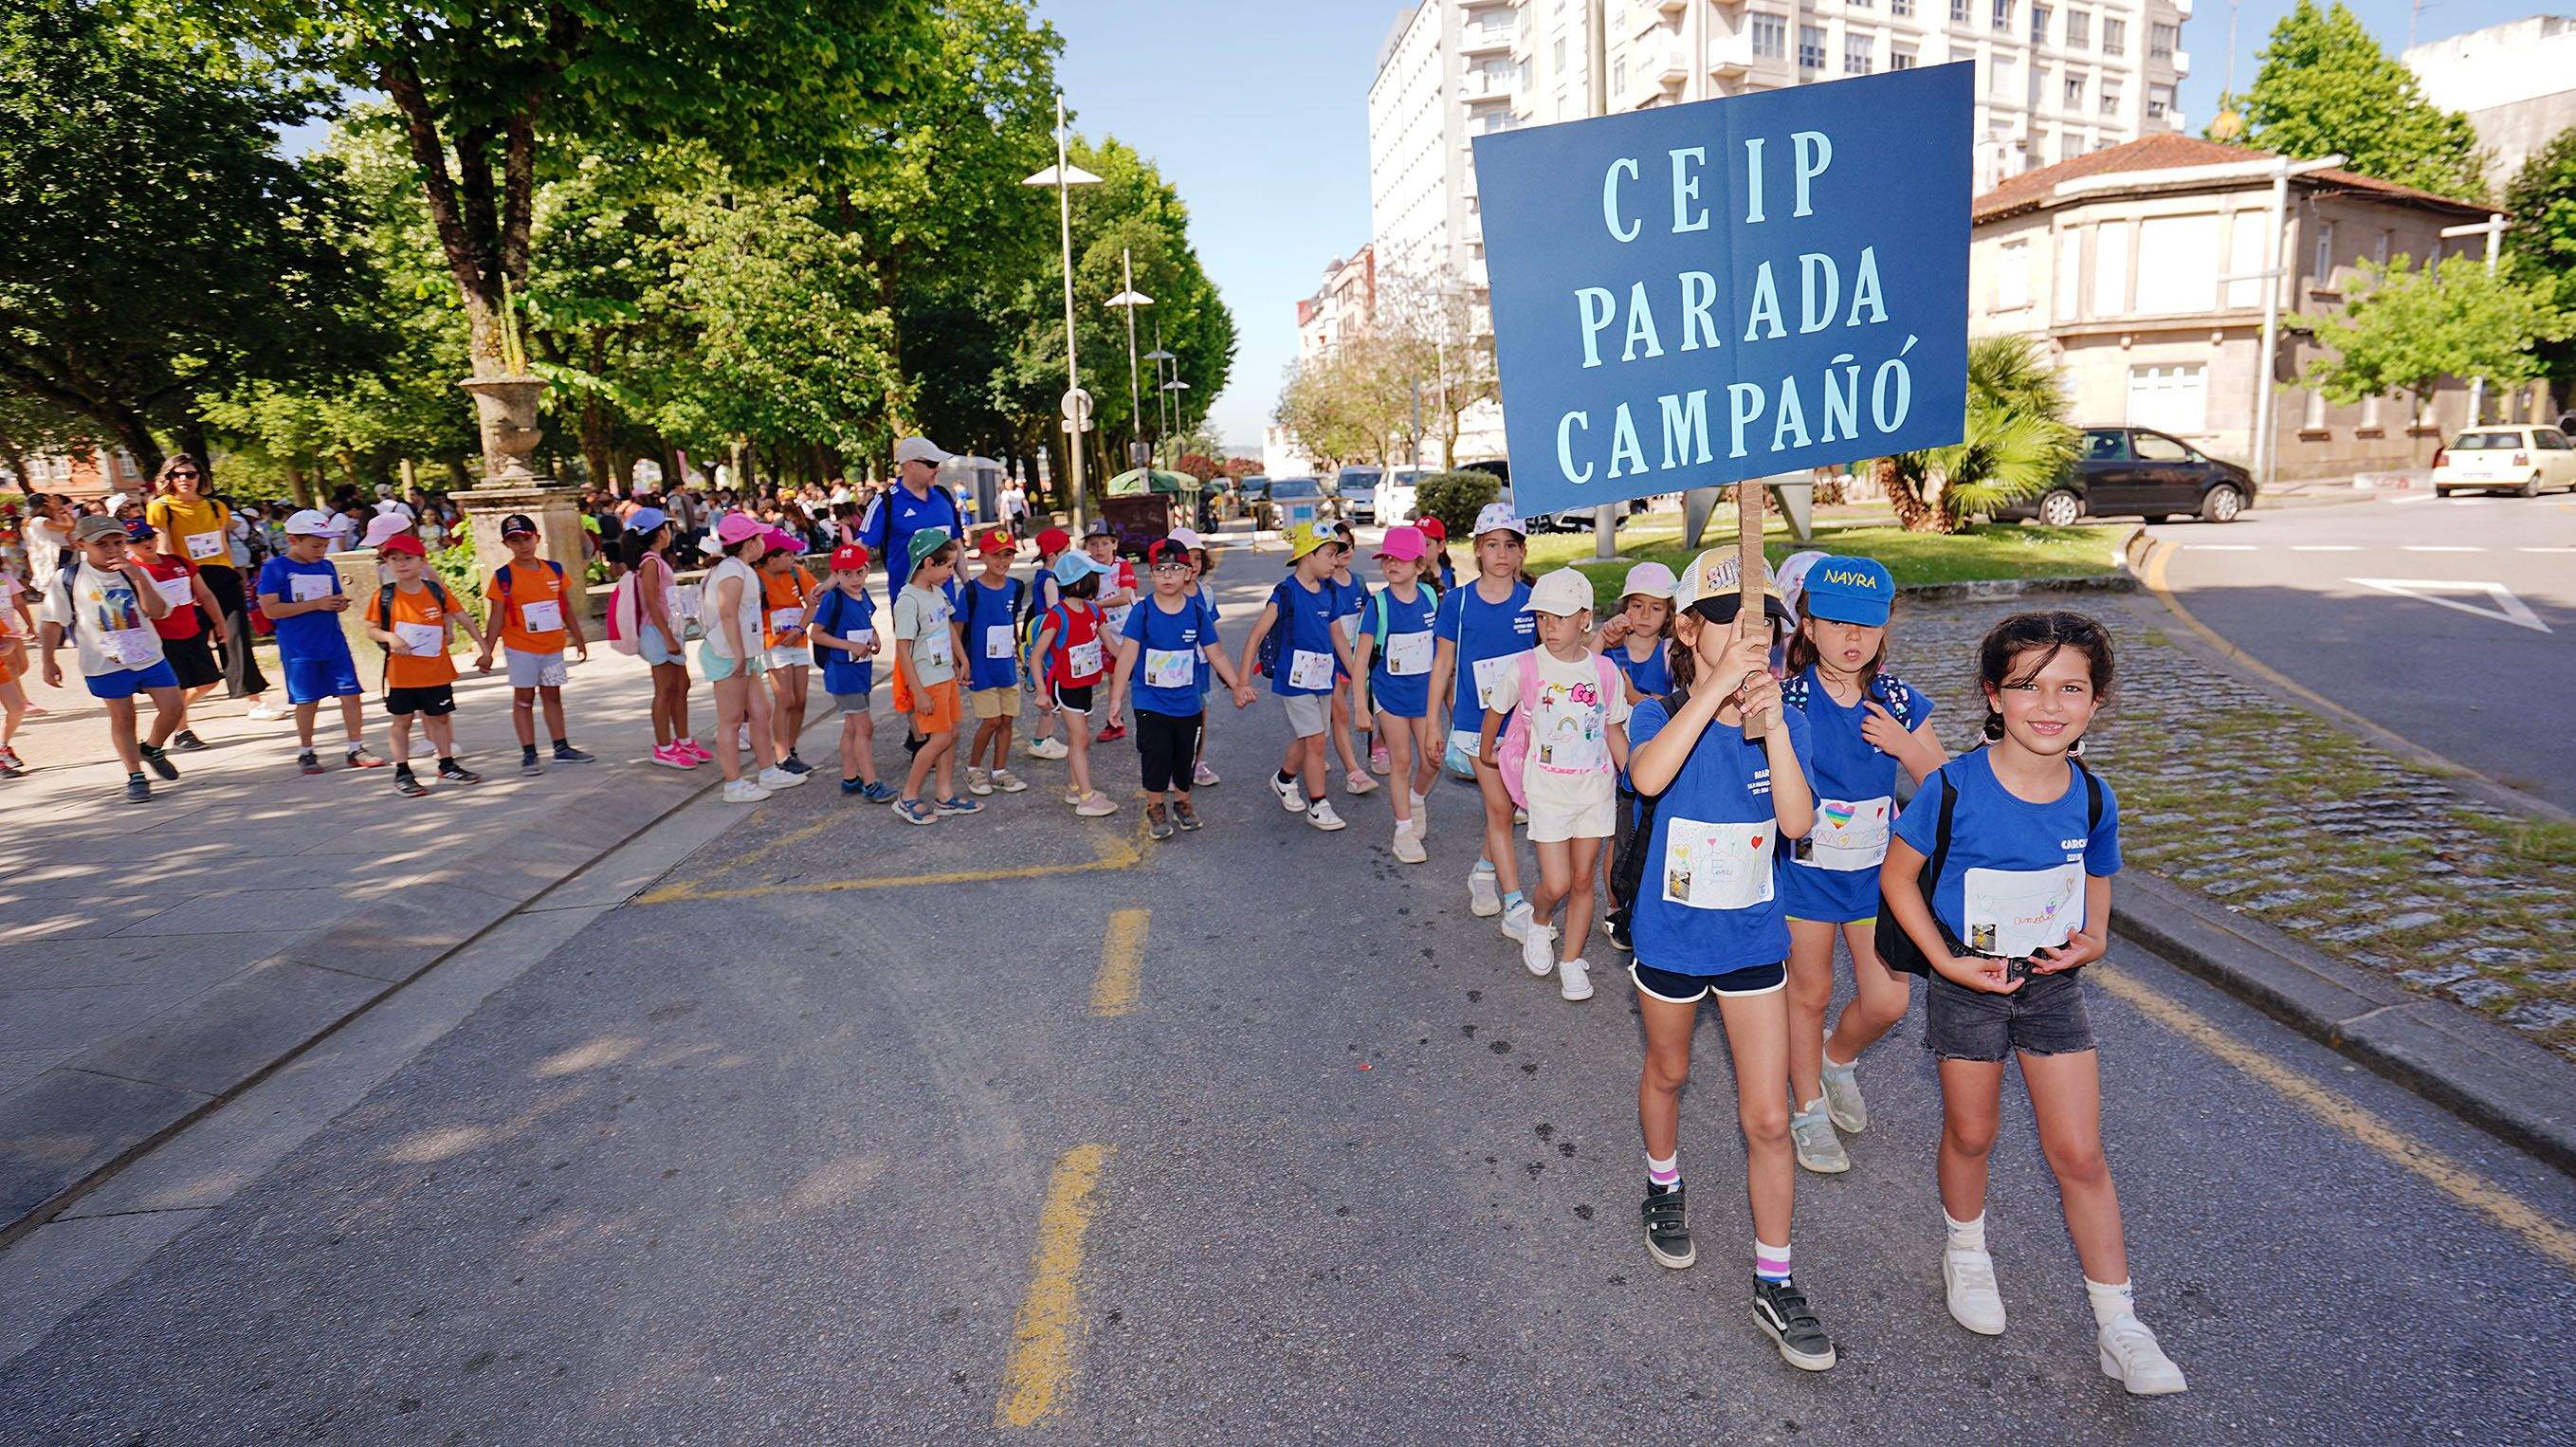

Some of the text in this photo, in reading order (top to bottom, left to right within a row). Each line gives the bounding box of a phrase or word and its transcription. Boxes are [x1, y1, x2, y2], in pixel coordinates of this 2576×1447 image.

[1603, 131, 1833, 243] CEIP
[1575, 246, 1889, 368] PARADA
[1557, 335, 1919, 485] CAMPAÑÓ
[1824, 569, 1876, 589] NAYRA
